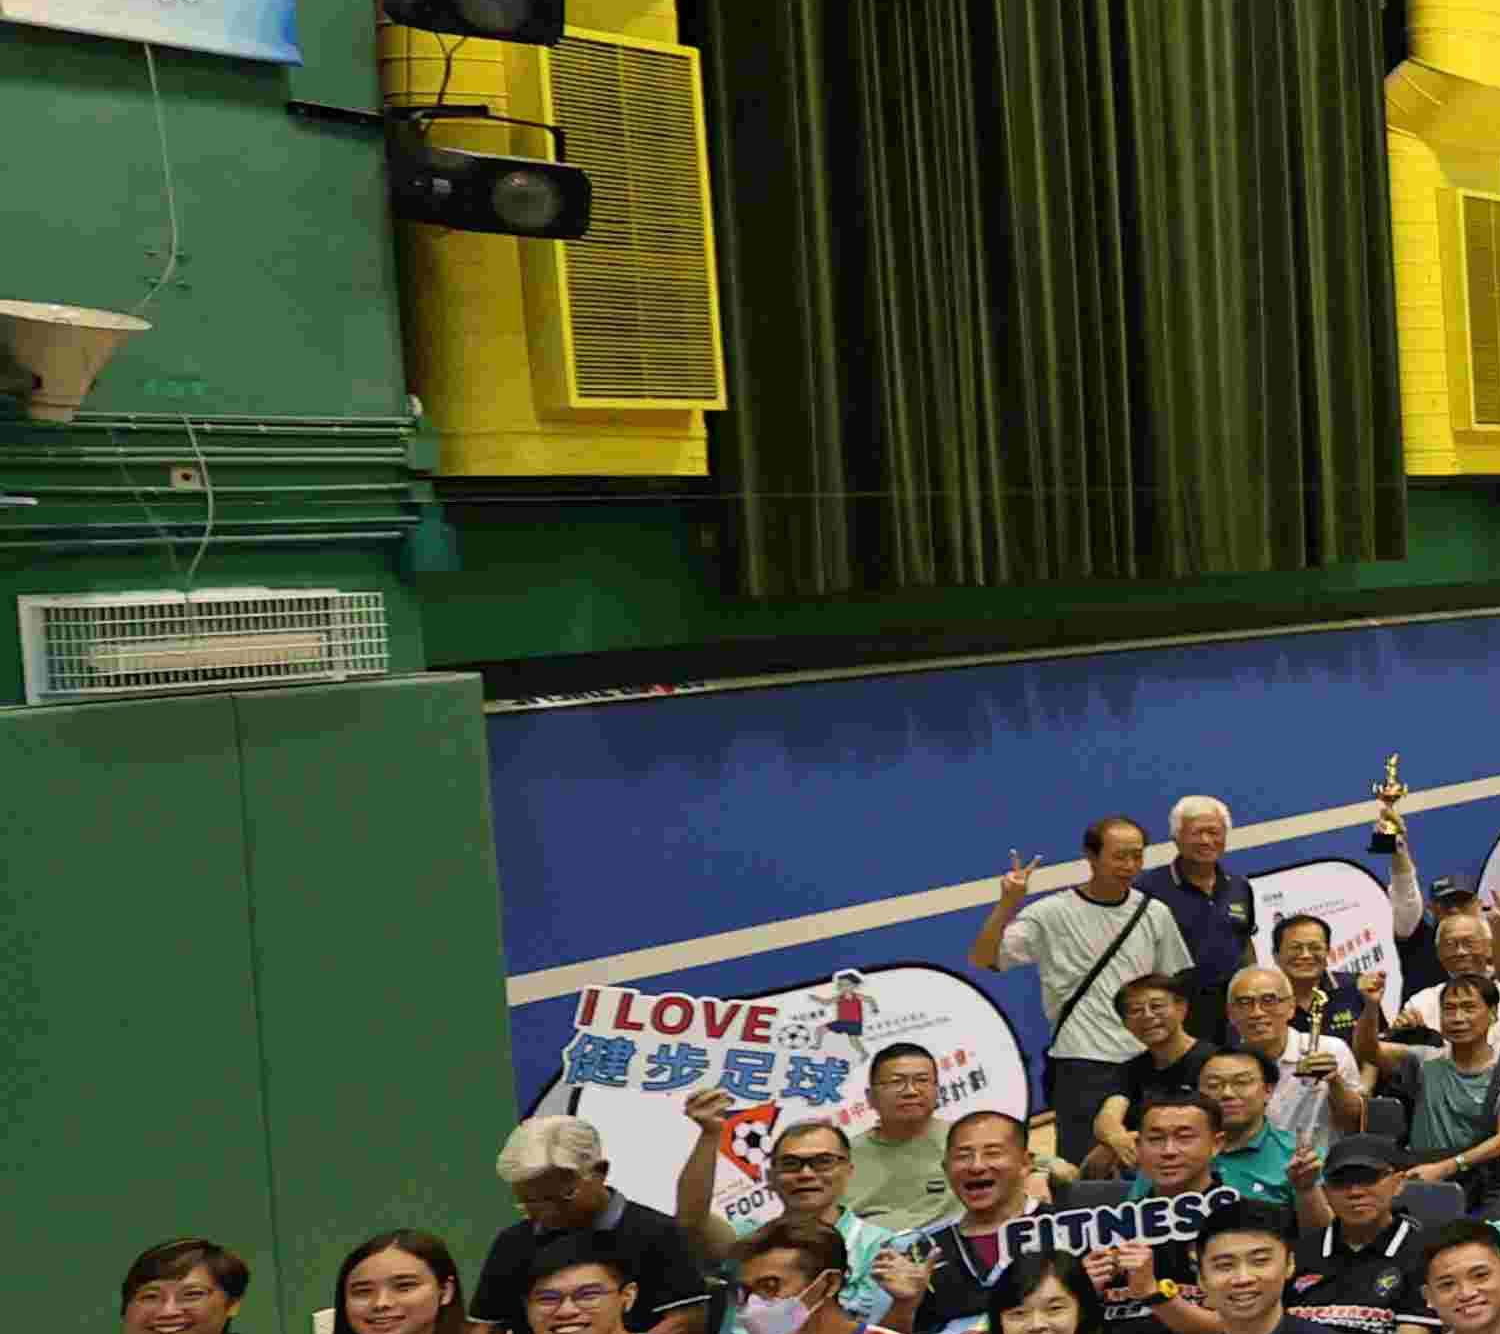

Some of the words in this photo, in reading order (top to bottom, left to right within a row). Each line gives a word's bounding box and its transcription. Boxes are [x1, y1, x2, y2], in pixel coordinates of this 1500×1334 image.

[578, 988, 600, 1027] I
[612, 992, 779, 1044] LOVE
[565, 1032, 850, 1105] 健步足球
